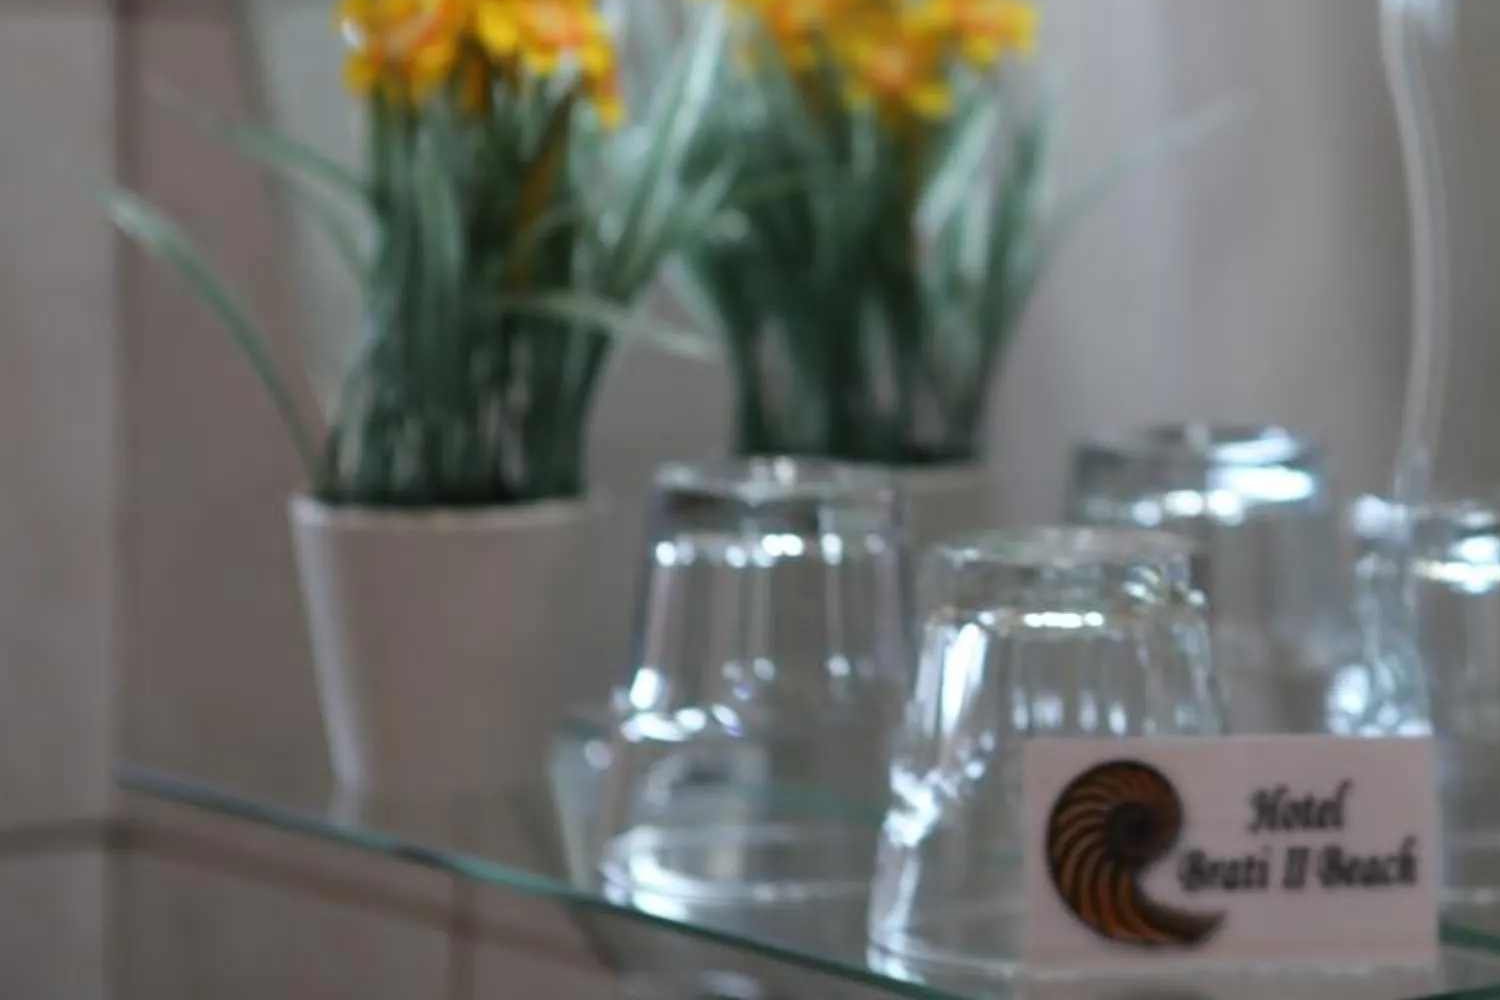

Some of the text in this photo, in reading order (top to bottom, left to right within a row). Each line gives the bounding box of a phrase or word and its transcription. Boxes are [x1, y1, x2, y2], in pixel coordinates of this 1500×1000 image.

[1247, 779, 1352, 835] Hotel
[1177, 845, 1270, 893] Brati
[1316, 834, 1419, 890] Beach
